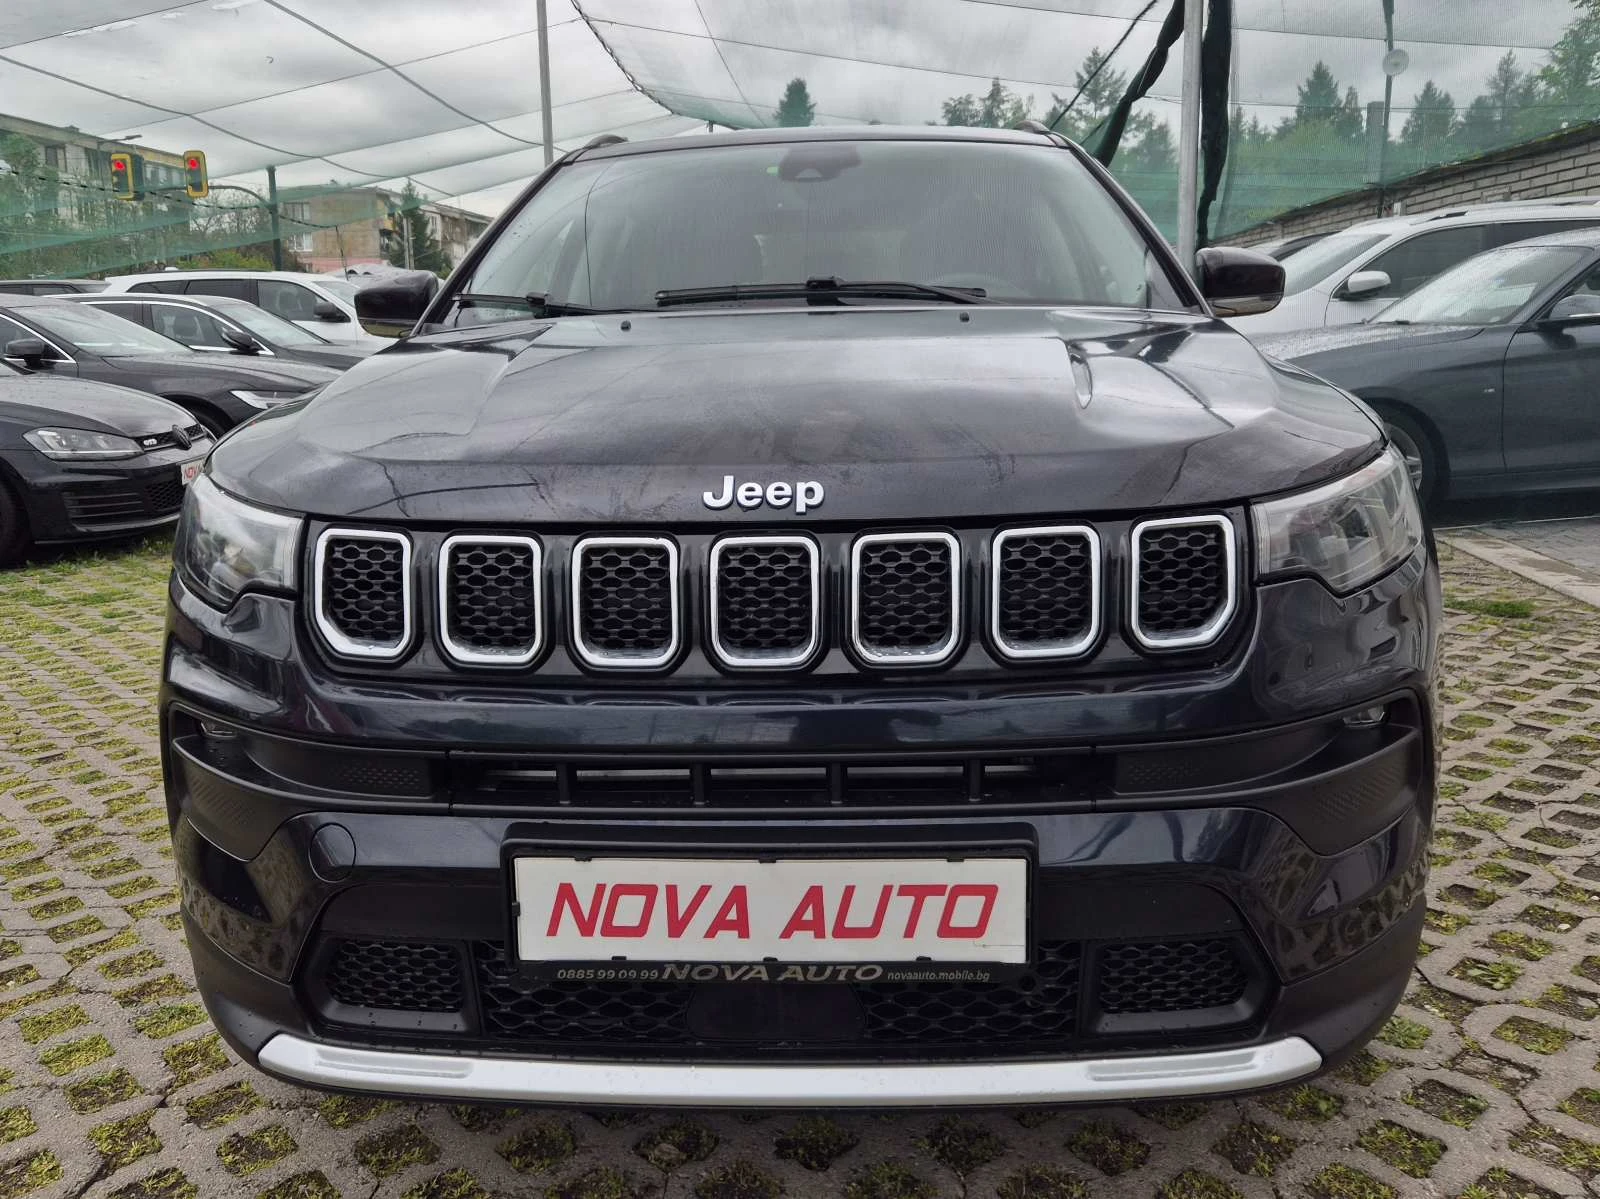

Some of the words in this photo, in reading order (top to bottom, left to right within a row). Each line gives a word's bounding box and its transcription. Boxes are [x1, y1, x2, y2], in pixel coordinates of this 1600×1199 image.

[703, 475, 825, 515] Jeep
[546, 882, 750, 939] NOVA
[779, 884, 999, 939] AUTO
[557, 969, 595, 980] 0885
[597, 969, 616, 980] 99
[618, 969, 637, 980] 09
[640, 969, 659, 980] 99
[661, 963, 770, 981] NOVA
[777, 964, 884, 981] AUTO
[887, 970, 991, 983] novaauto.mobile.bg
